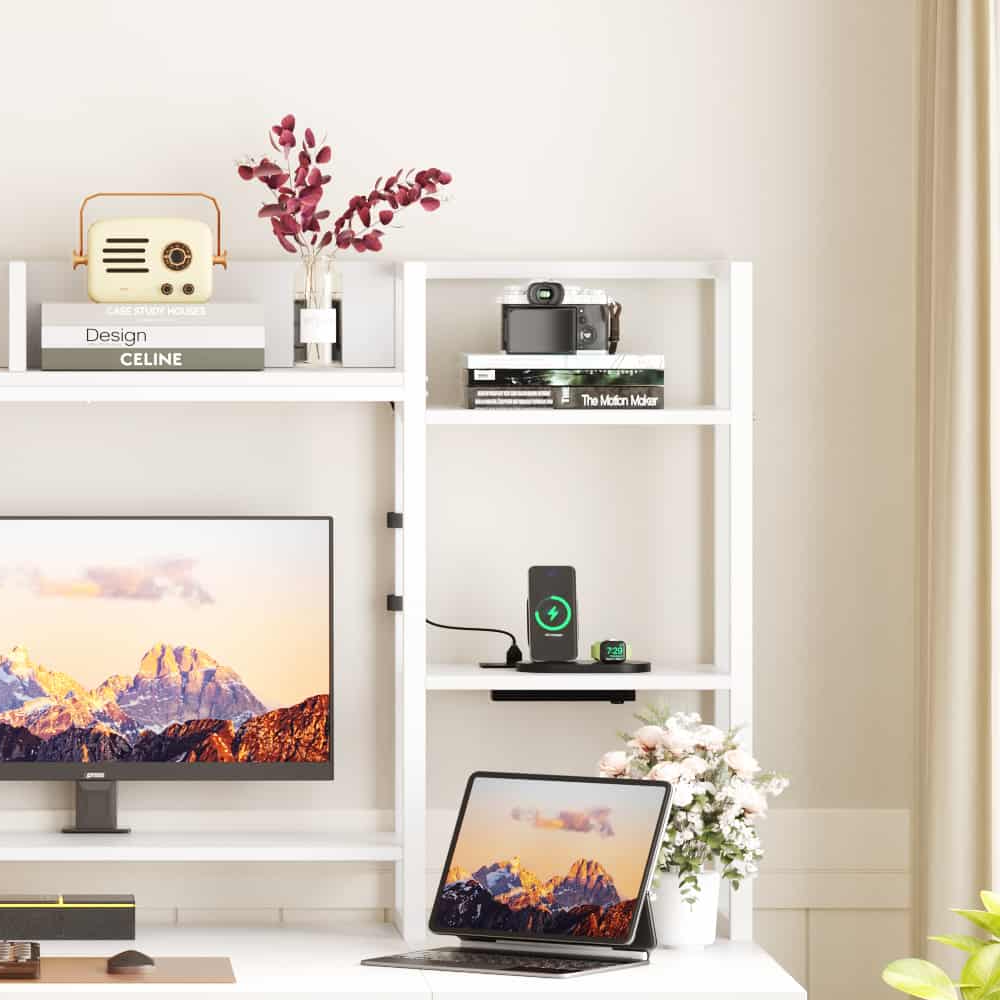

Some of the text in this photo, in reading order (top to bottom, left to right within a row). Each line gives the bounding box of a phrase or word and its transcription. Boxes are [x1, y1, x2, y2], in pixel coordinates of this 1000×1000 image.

[86, 328, 147, 346] Design
[120, 352, 183, 366] CELINE
[581, 394, 598, 406] The
[600, 394, 629, 406] Motion
